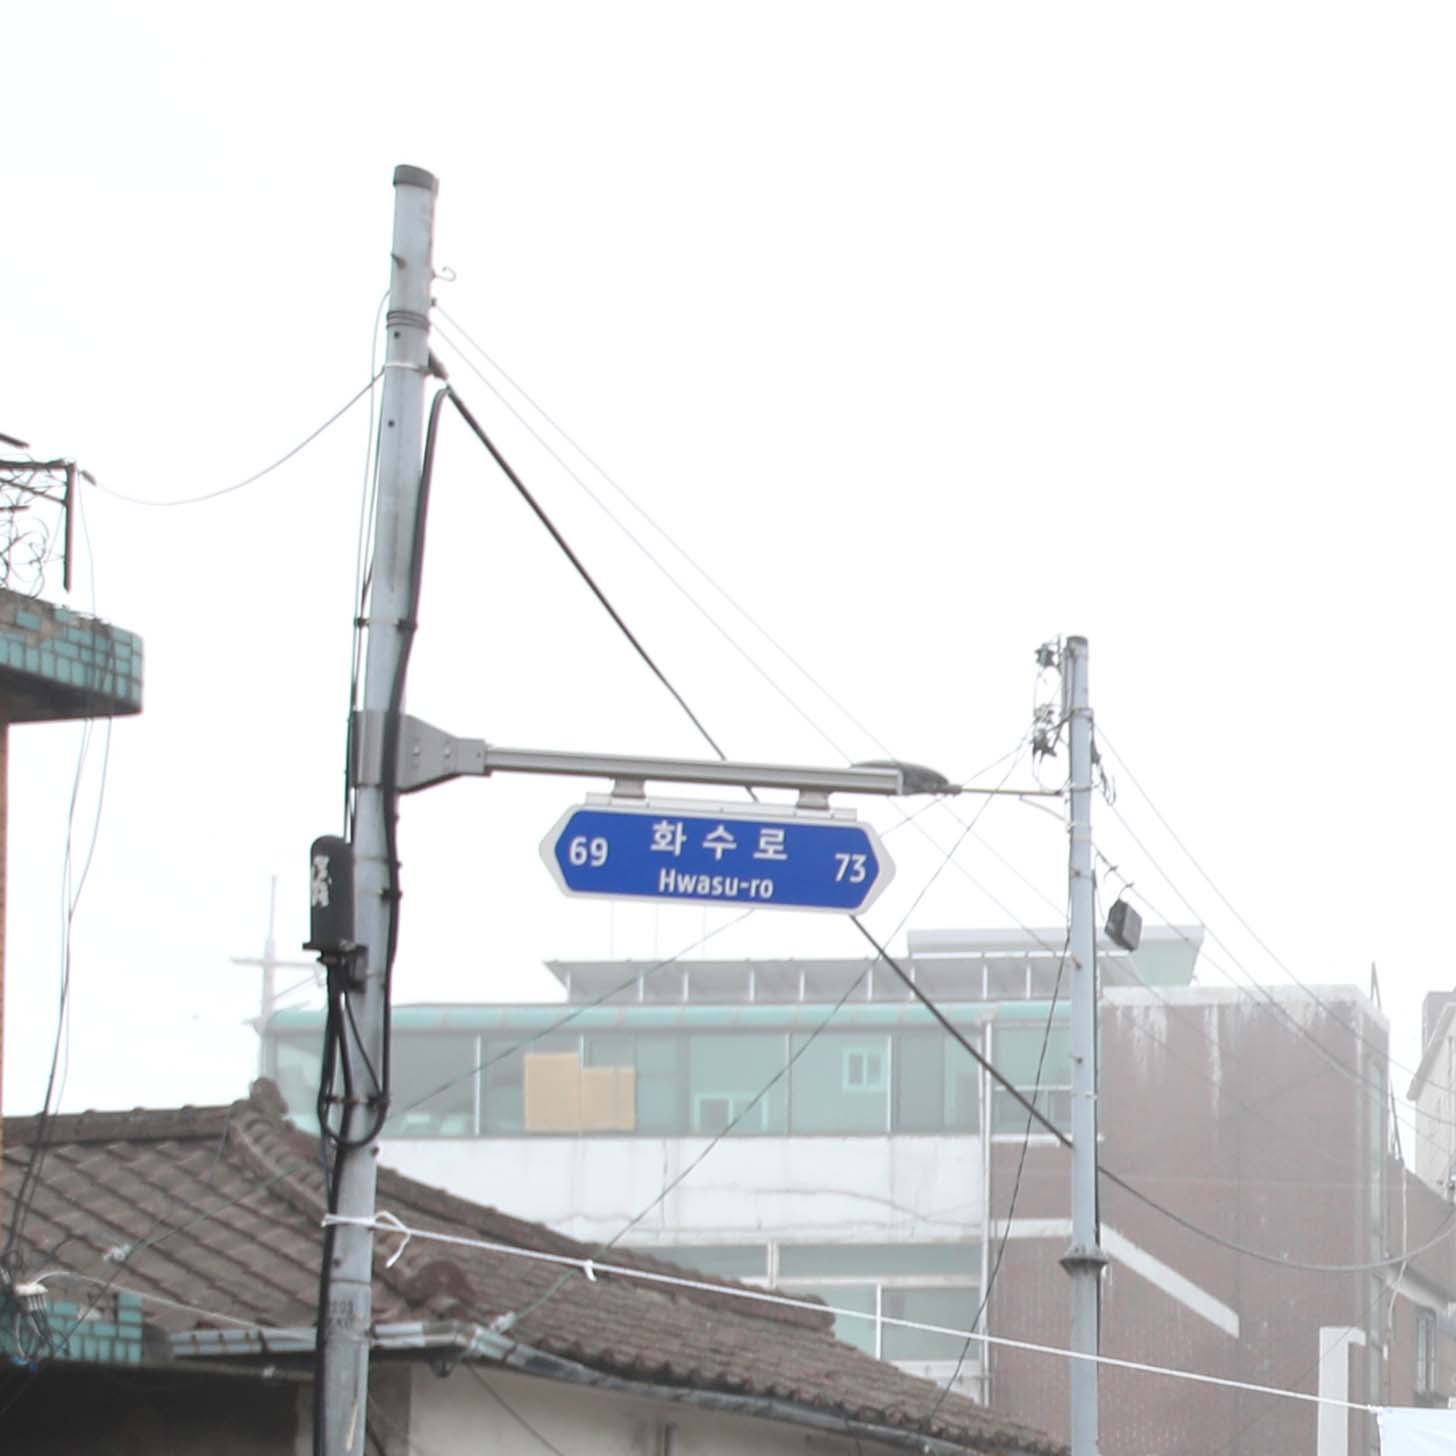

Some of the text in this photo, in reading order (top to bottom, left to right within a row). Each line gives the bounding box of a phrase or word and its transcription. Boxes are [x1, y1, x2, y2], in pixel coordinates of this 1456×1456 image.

[568, 837, 608, 867] 69
[659, 868, 774, 898] Hwasu-ro
[834, 853, 867, 883] 73
